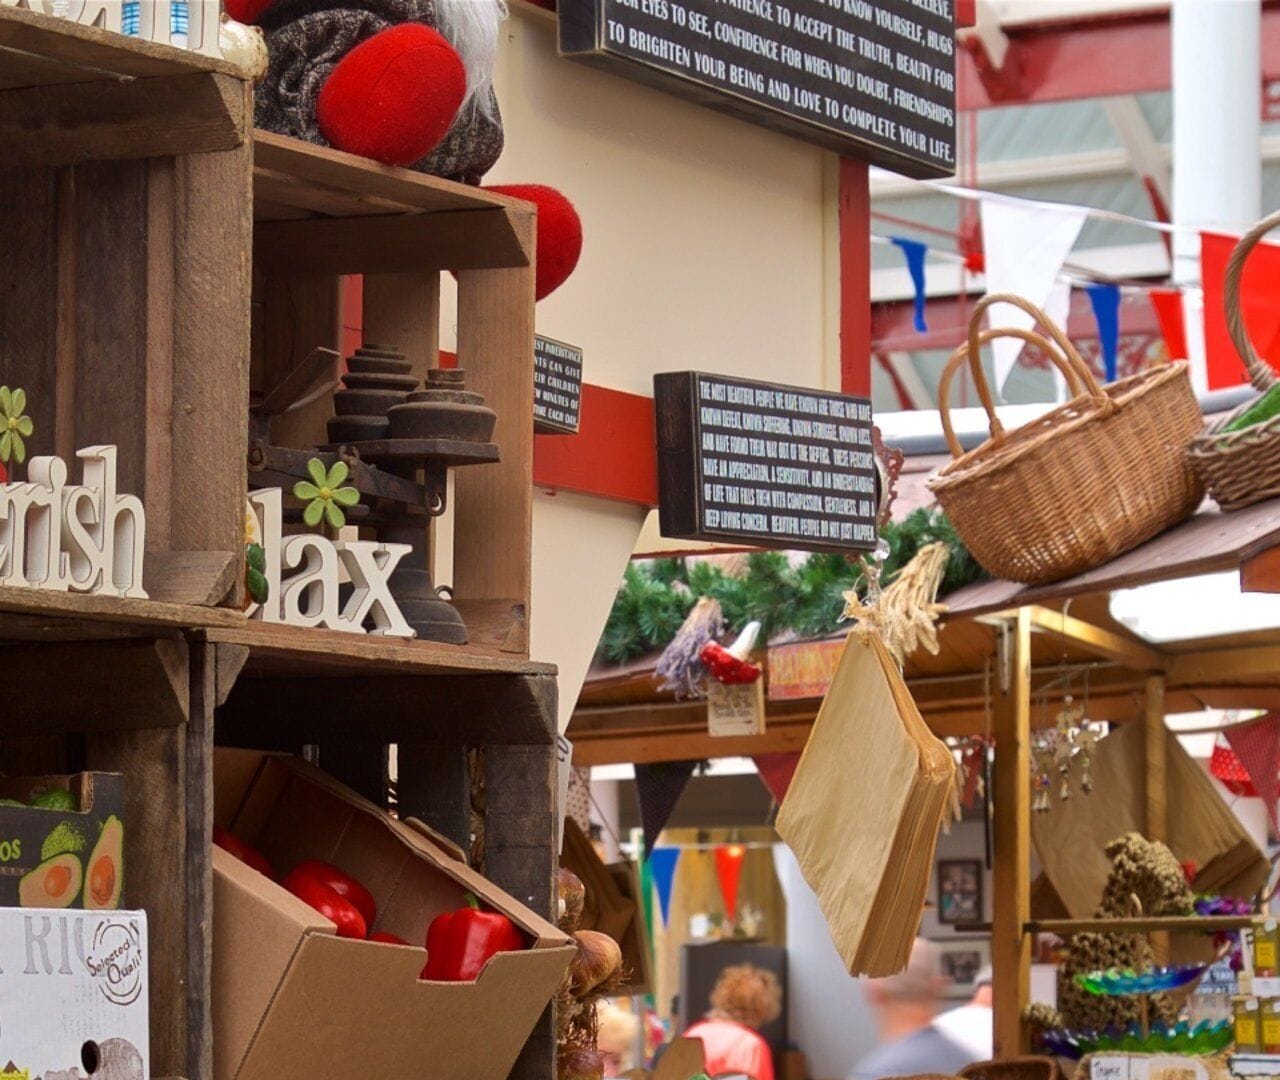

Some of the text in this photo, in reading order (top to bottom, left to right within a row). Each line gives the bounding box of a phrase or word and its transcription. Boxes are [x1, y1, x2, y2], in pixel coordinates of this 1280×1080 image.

[843, 0, 953, 56] KNOW YOURSELF, HUGS
[776, 5, 791, 28] TO
[793, 13, 833, 43] ACCEPT
[835, 27, 856, 52] THE
[858, 36, 894, 70] TRUTH,
[896, 51, 933, 83] BEAUTY
[934, 68, 954, 92] FOR
[642, 0, 953, 127] EYES TO SEE, CONFIDENCE FOR WHEN YOU DOUBT, FRIENDSHIPS
[608, 20, 954, 163] TO BRIGHTEN YOUR BEING AND LOVE TO COMPLETE YOUR LIFE.
[549, 360, 580, 379] CAN GIVE
[542, 390, 569, 408] MINUTES
[548, 376, 580, 394] CHILDREN
[704, 458, 718, 477] HAVE
[704, 484, 712, 500] OF
[712, 484, 724, 502] LIFE
[725, 486, 739, 504] THAT
[705, 509, 720, 527] DEEP
[800, 518, 820, 536] PEOPLE
[821, 520, 828, 537] DO
[829, 521, 840, 538] NOT
[86, 938, 130, 976] Selected
